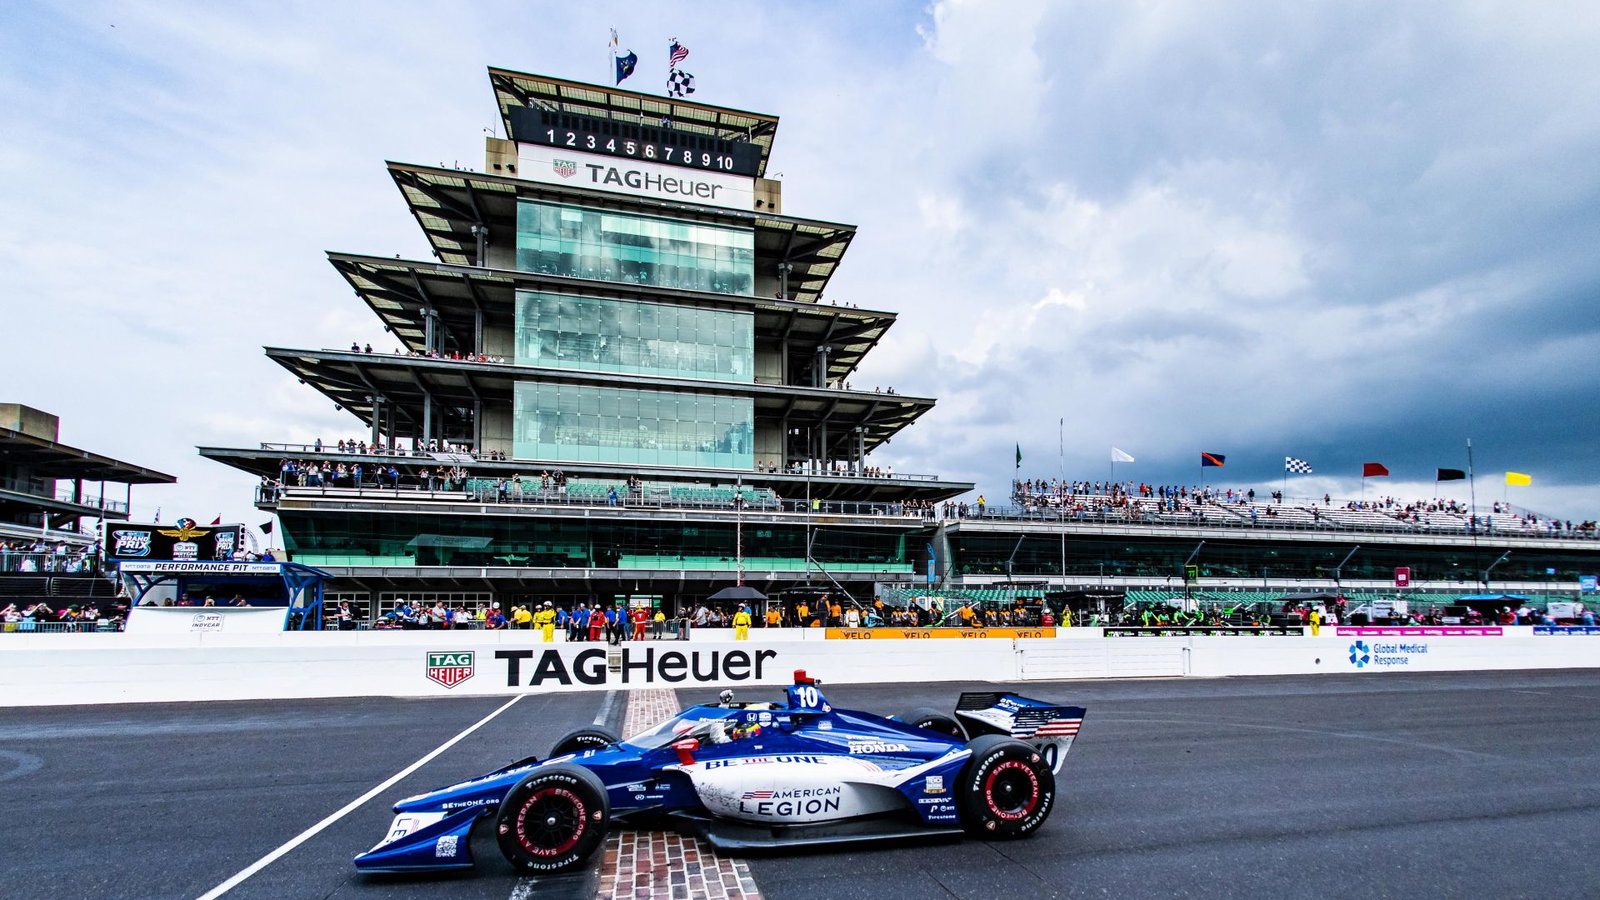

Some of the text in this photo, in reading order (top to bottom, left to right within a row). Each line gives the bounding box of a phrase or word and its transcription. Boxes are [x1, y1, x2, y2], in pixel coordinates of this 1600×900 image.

[547, 130, 733, 170] 1 2 3 4 5 6 7 8 9 10
[115, 540, 151, 549] PRIX
[154, 563, 249, 572] PERFORMANCE PIT
[1374, 643, 1428, 653] Global Medical
[431, 655, 470, 666] TAG
[1374, 655, 1408, 666] Response
[430, 668, 470, 684] HEUER
[795, 686, 818, 708] 10
[576, 736, 610, 746] Fireston
[848, 744, 910, 754] HONDA
[706, 760, 738, 770] BE
[776, 756, 828, 764] ONE
[973, 751, 1004, 792] Firestone
[526, 775, 577, 788] Firestone
[993, 761, 1010, 775] SAVE
[1021, 762, 1038, 798] VETERAN
[773, 786, 840, 799] AMERICAN
[740, 797, 840, 815] LEGION
[1021, 792, 1051, 831] Firestone
[517, 796, 537, 840] VETERAN
[532, 848, 557, 856] SAVE
[528, 854, 579, 870] Firestone
